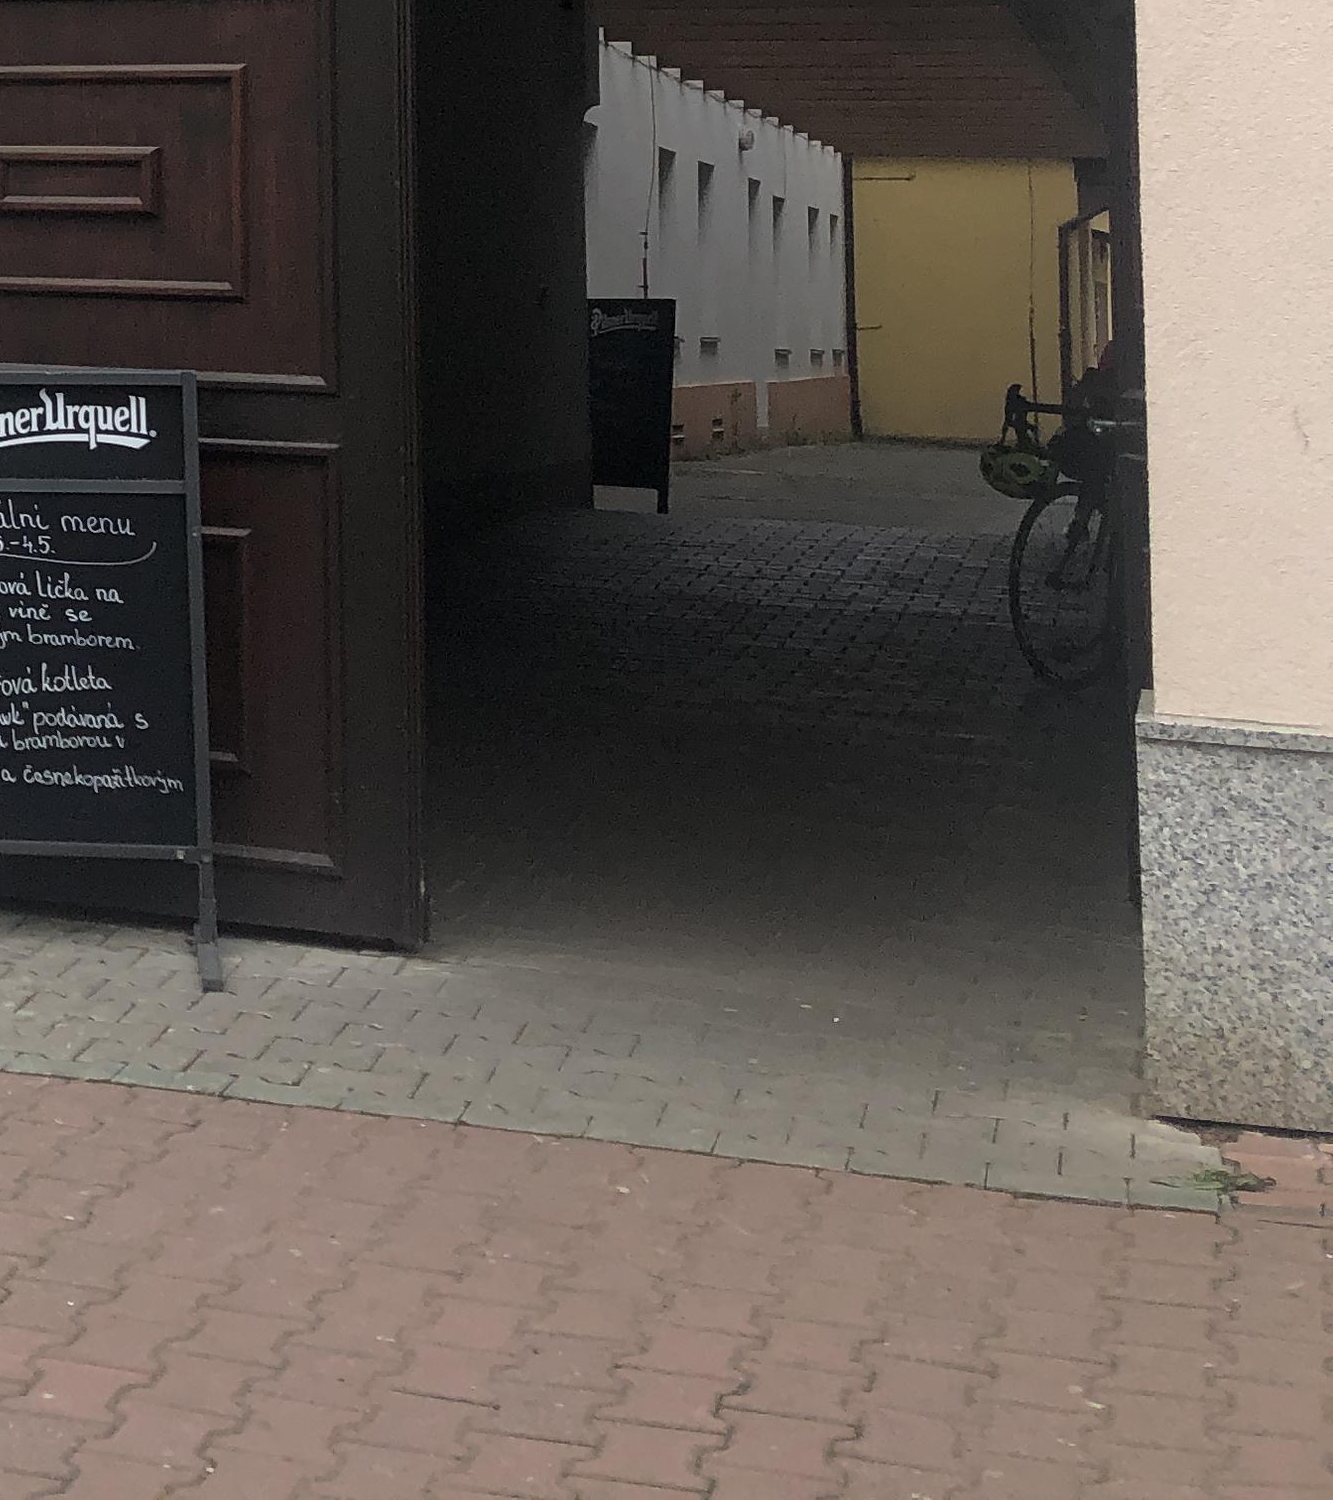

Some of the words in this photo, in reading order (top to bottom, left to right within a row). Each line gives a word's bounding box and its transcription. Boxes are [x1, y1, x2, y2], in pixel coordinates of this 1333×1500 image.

[60, 515, 136, 536] menu
[95, 587, 125, 604] na
[64, 607, 93, 622] se
[41, 662, 113, 693] kotleta
[32, 702, 125, 735] podávaná
[134, 712, 150, 730] s
[11, 729, 113, 751] bramborou
[115, 733, 126, 750] v
[0, 768, 17, 783] a
